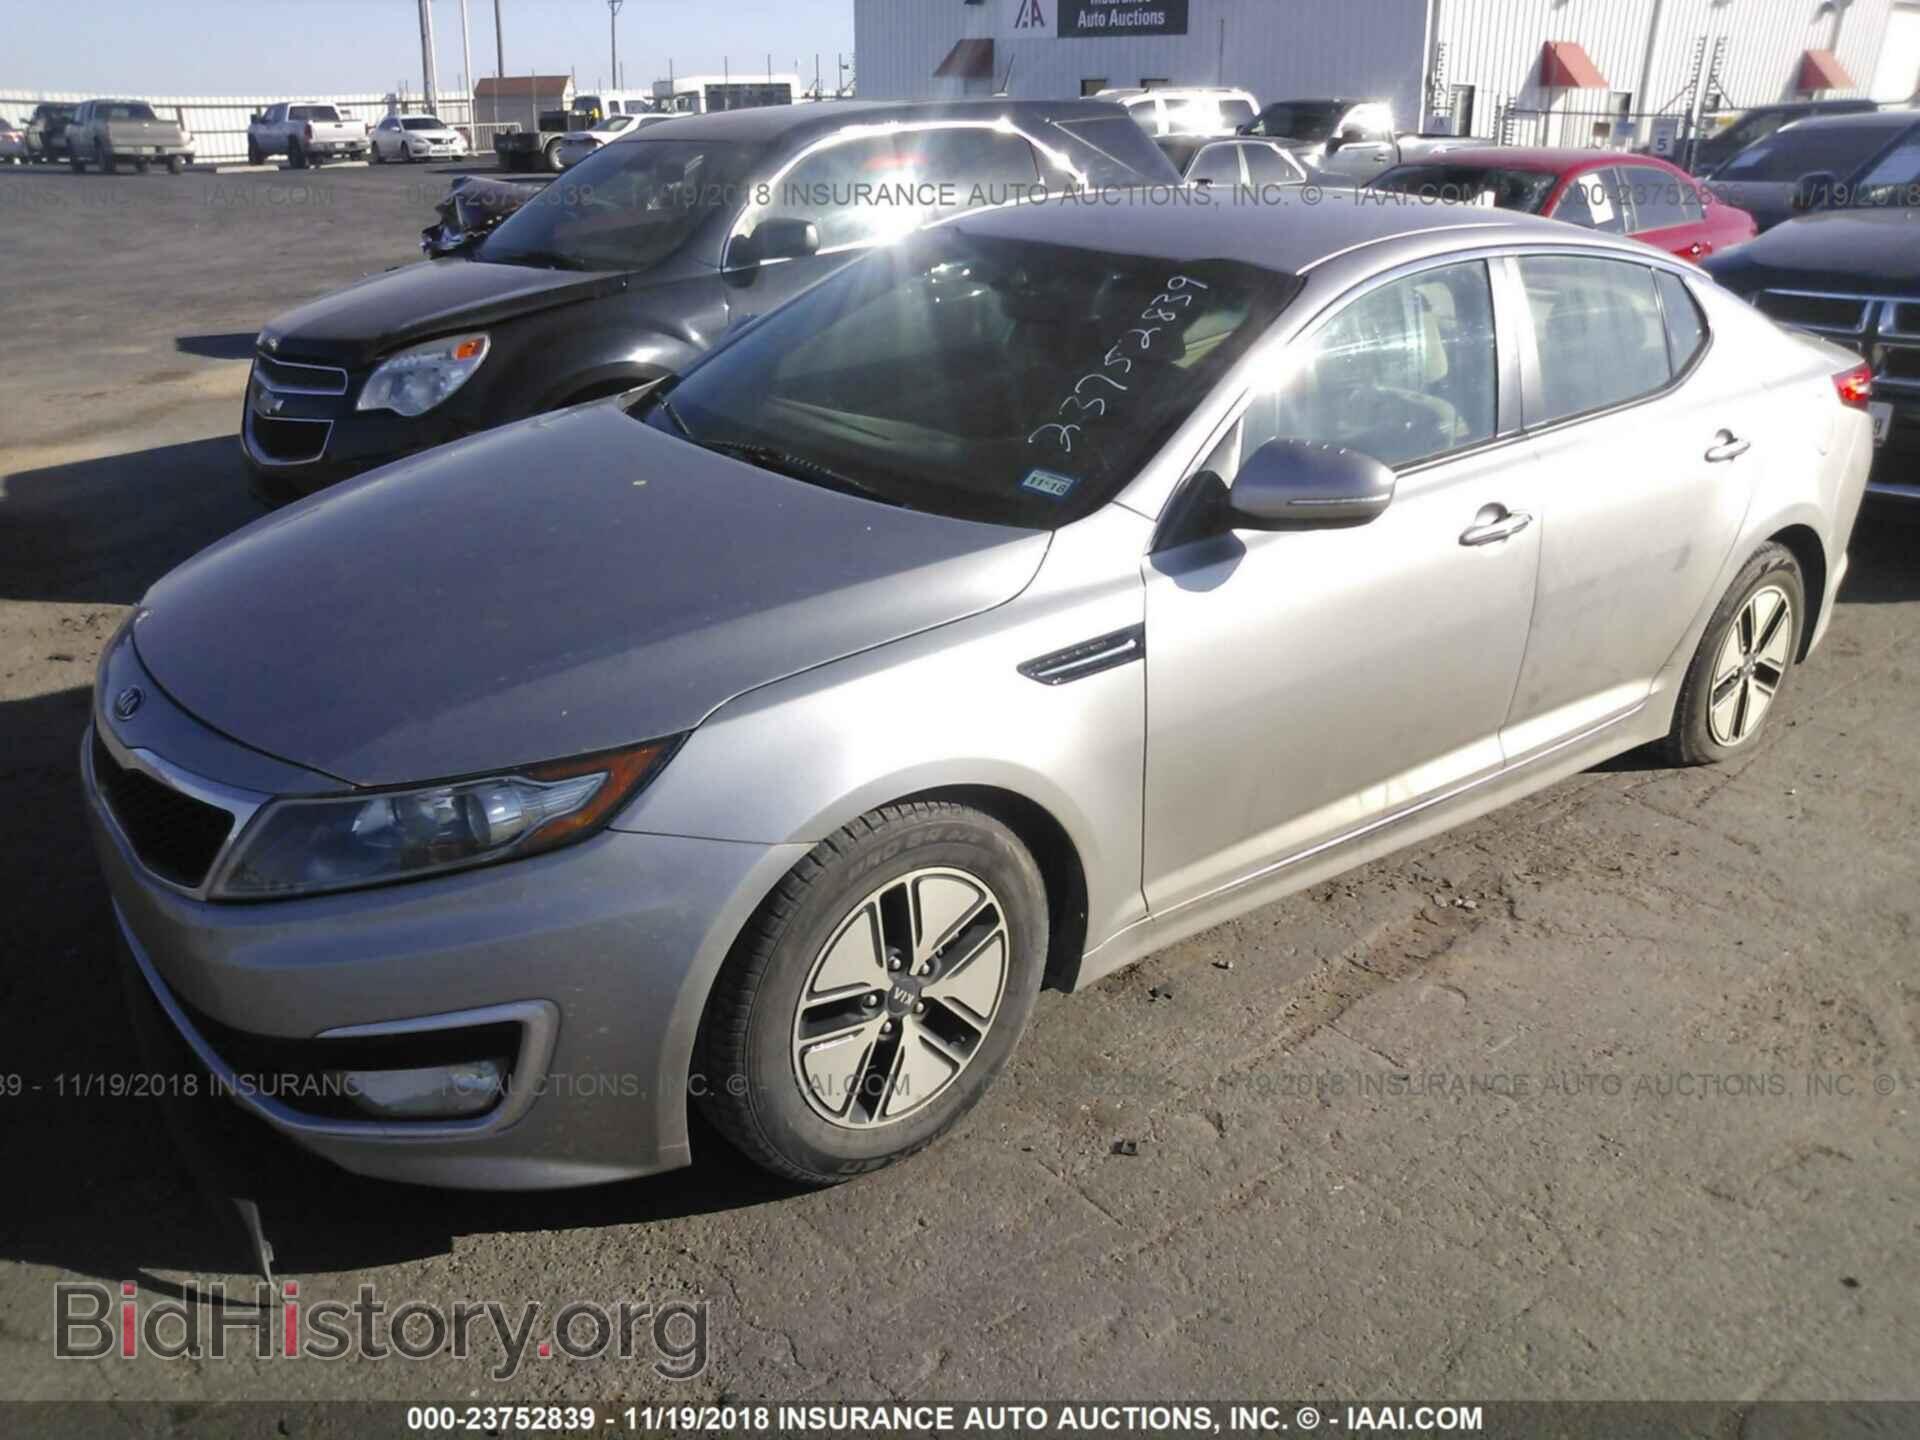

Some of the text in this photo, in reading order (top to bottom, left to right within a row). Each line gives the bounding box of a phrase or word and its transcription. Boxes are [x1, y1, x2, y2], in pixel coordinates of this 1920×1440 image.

[1078, 8, 1166, 28] Auto Auctions
[893, 986, 915, 1007] KIA
